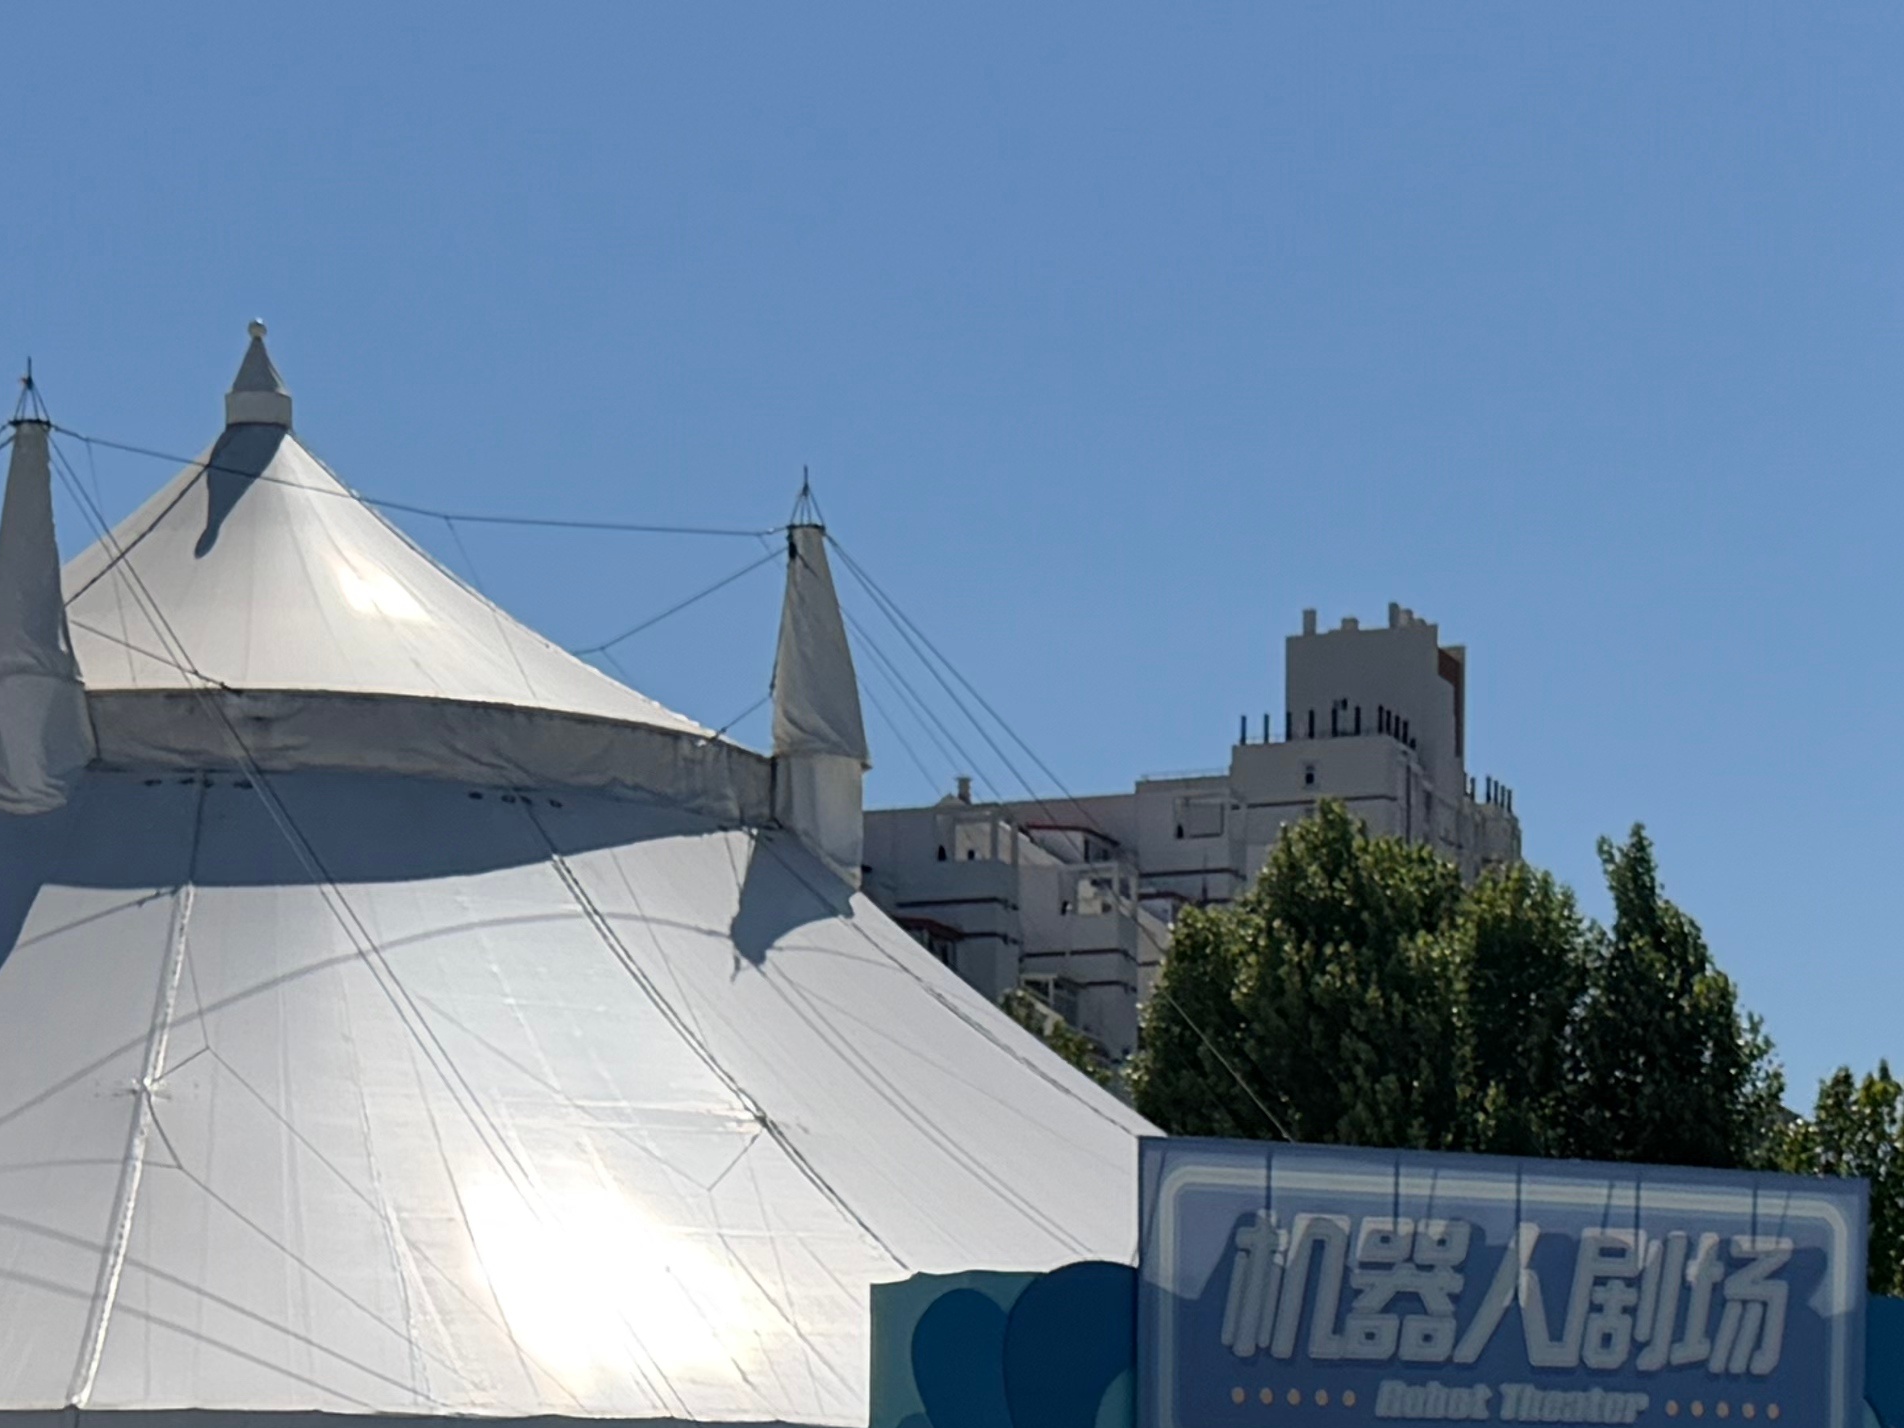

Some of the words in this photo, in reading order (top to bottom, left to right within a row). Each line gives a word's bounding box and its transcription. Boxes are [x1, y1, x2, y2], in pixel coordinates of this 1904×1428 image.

[1222, 1210, 1793, 1375] 机器人剧场
[1375, 1380, 1492, 1419] Robot
